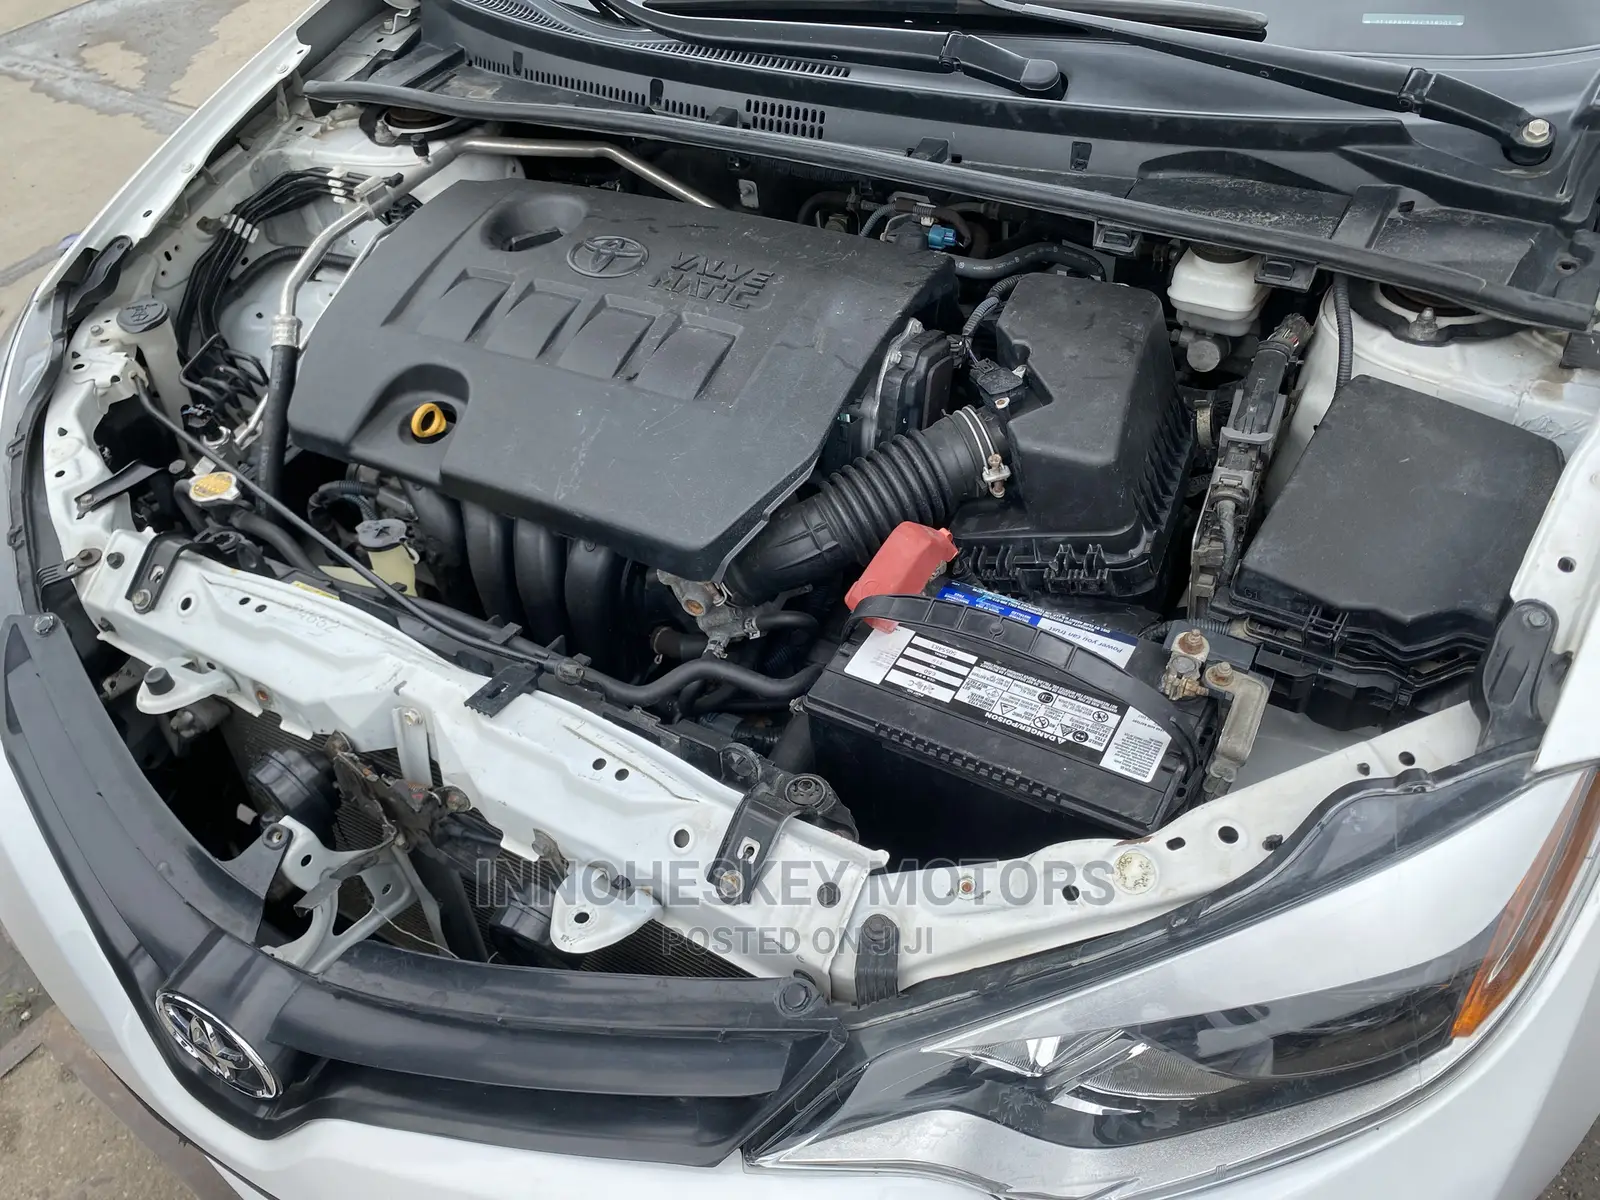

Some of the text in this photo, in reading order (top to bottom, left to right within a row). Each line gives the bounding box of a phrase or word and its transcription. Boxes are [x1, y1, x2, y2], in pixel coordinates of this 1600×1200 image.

[671, 252, 775, 290] VALVE
[648, 273, 760, 309] MATIC
[1047, 625, 1123, 653] Power you can trust
[984, 711, 1056, 741] DANGER/POISON
